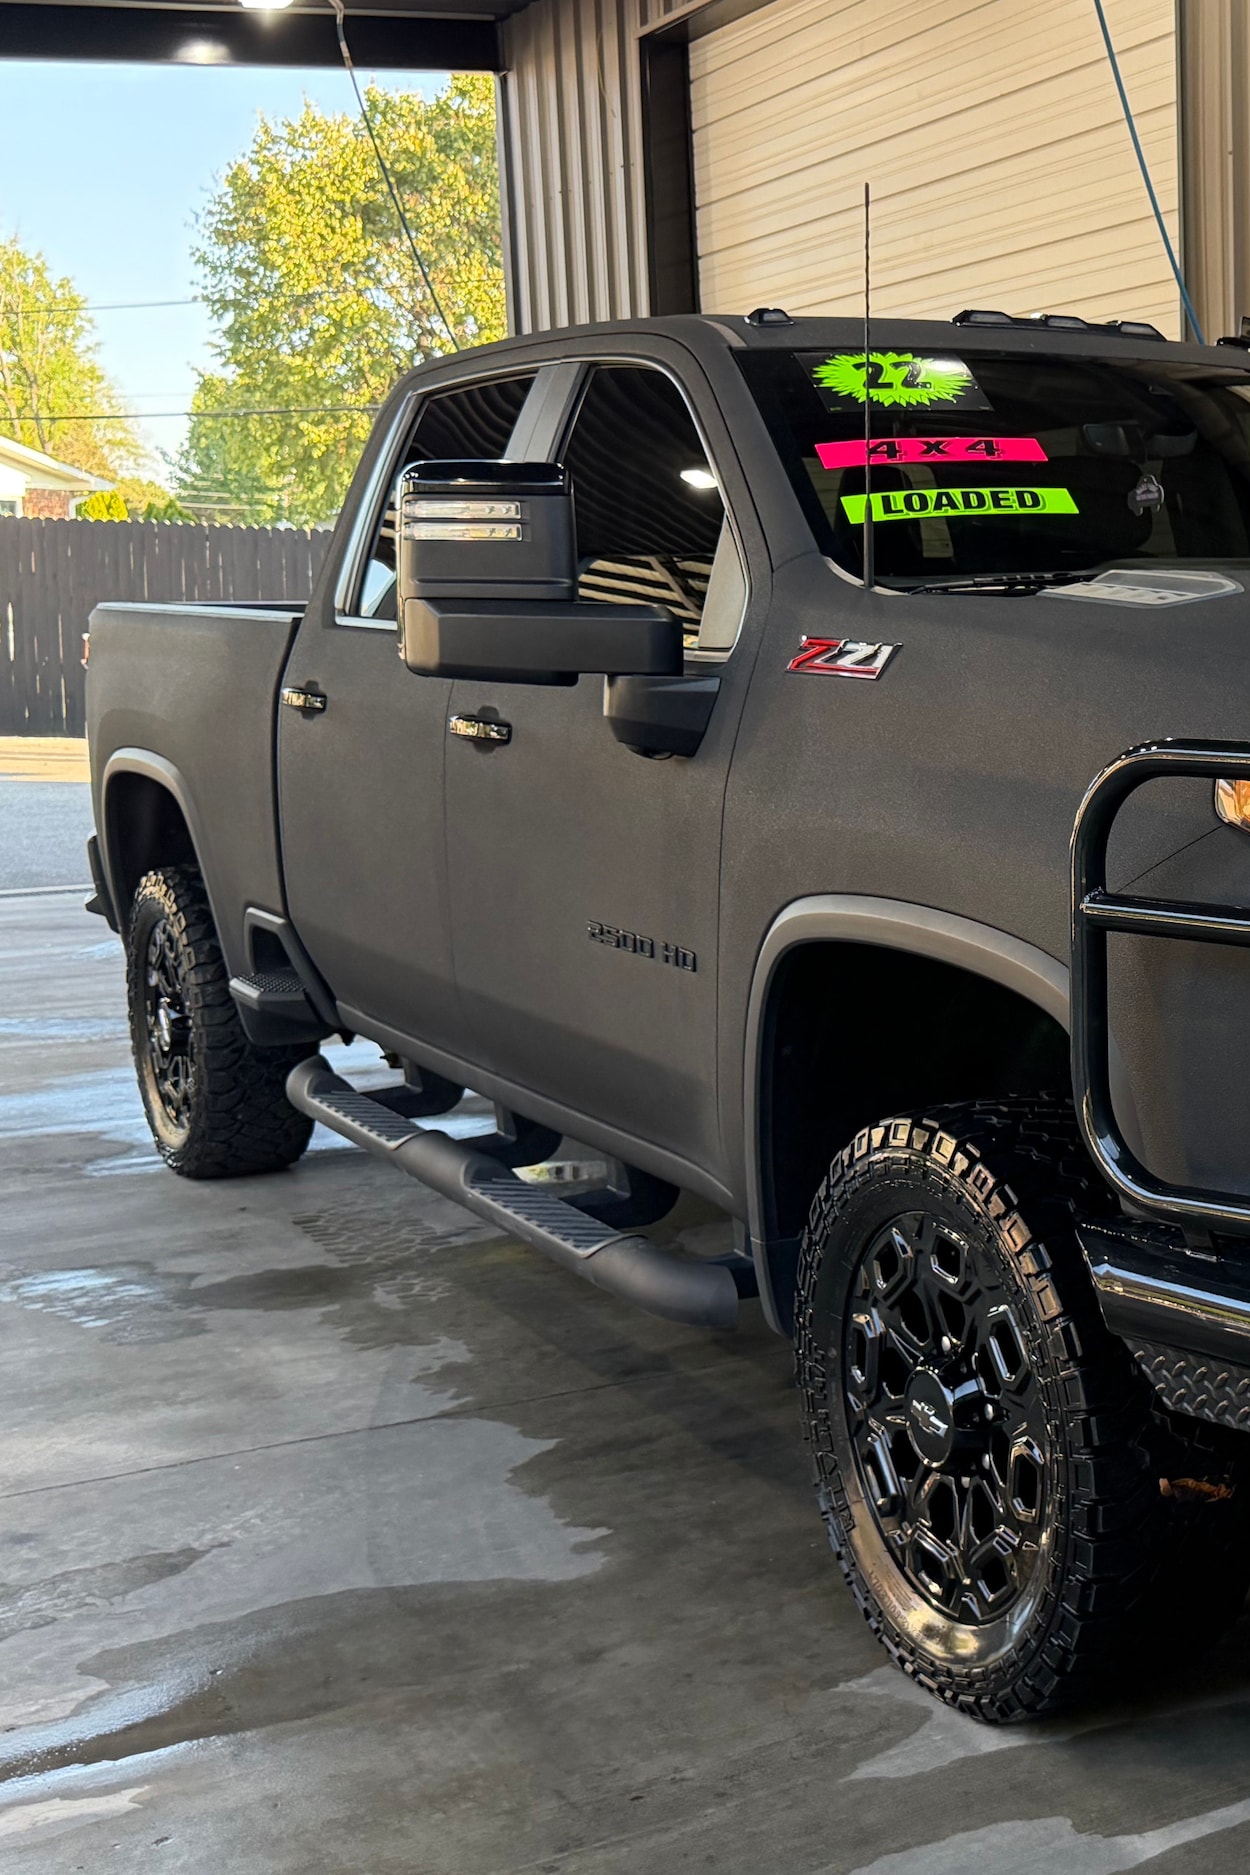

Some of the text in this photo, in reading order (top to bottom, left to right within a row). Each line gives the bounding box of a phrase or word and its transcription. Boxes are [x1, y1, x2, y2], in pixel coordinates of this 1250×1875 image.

[852, 361, 932, 390] 22
[882, 490, 1044, 515] LOADED
[785, 635, 903, 681] Z71
[586, 919, 697, 973] 2500 HD
